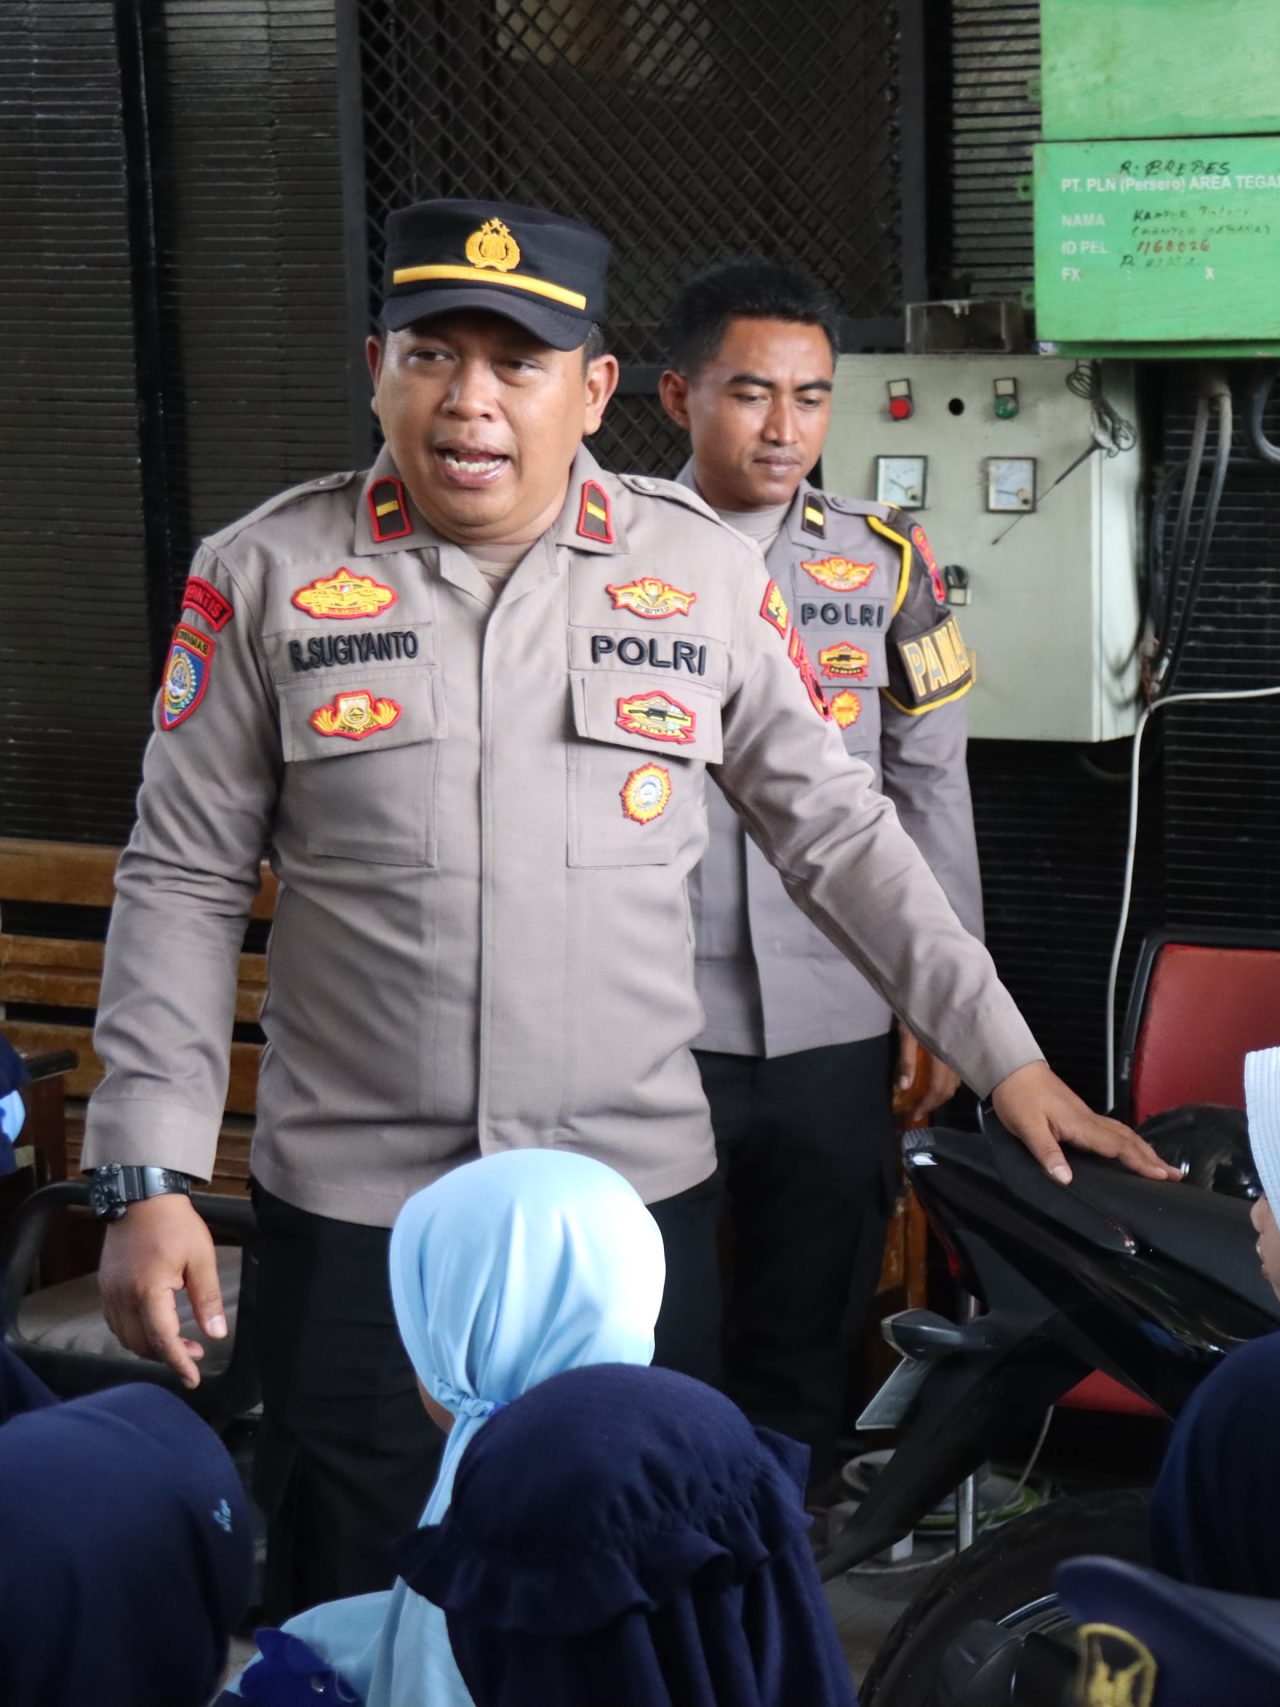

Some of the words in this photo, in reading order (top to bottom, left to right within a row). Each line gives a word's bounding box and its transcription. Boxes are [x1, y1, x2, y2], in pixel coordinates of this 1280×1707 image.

[1061, 178, 1082, 192] PT.
[1087, 177, 1116, 192] PLN
[1120, 177, 1186, 195] (Persero)
[1190, 175, 1232, 190] AREA
[1061, 213, 1105, 227] NAMA
[1061, 241, 1077, 254] ID
[1081, 240, 1109, 254] PEL
[801, 602, 884, 628] POLRI
[591, 634, 707, 676] POLRI
